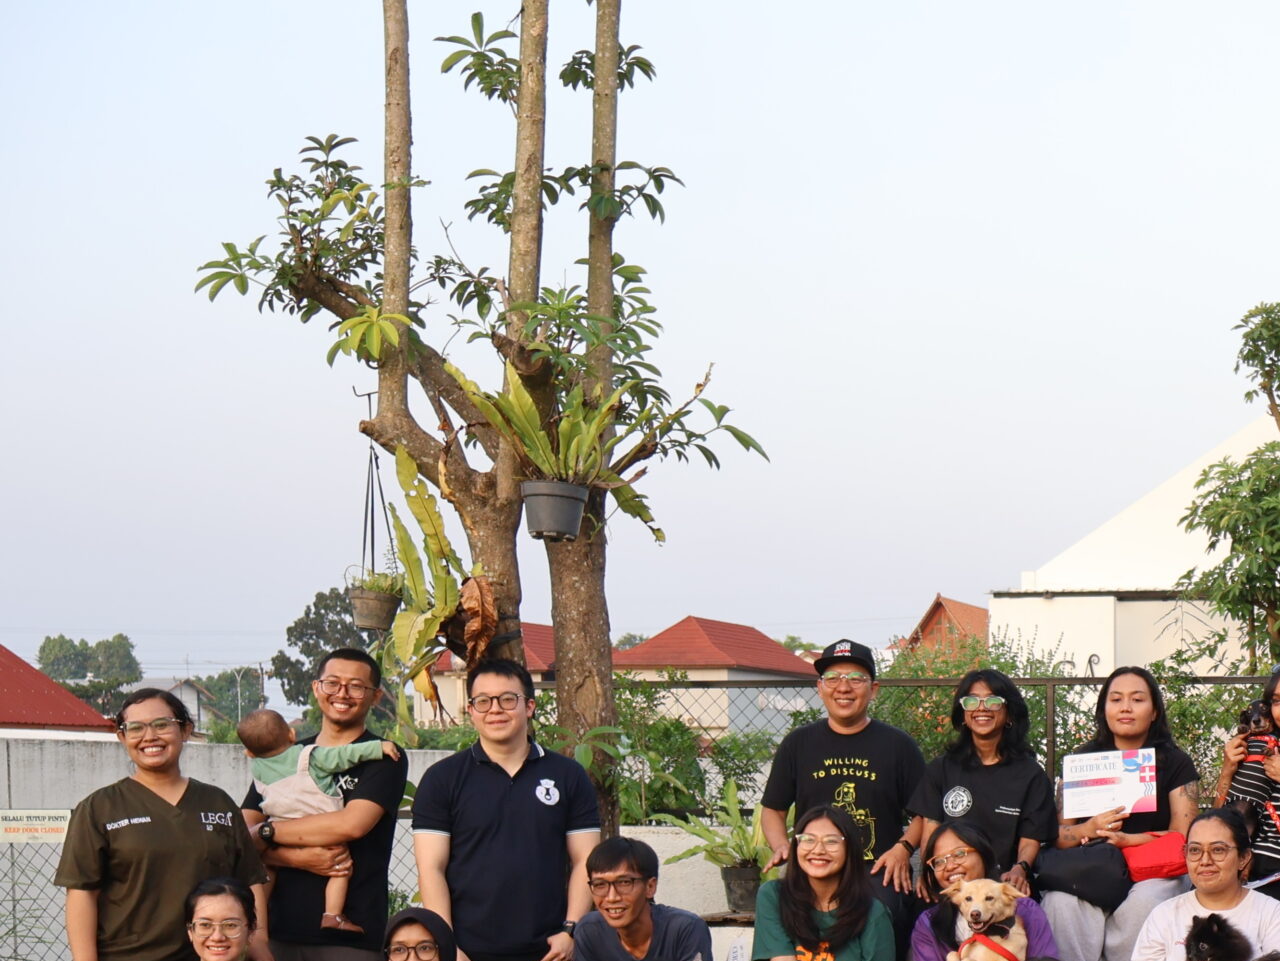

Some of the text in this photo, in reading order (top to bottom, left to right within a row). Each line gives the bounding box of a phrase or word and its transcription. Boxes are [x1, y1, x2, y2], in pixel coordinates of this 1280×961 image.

[824, 757, 869, 767] WILLING
[1070, 762, 1117, 774] CERTIFICATE
[812, 767, 877, 781] TO DISCUSS
[106, 816, 151, 830] DOKTER HEWAN
